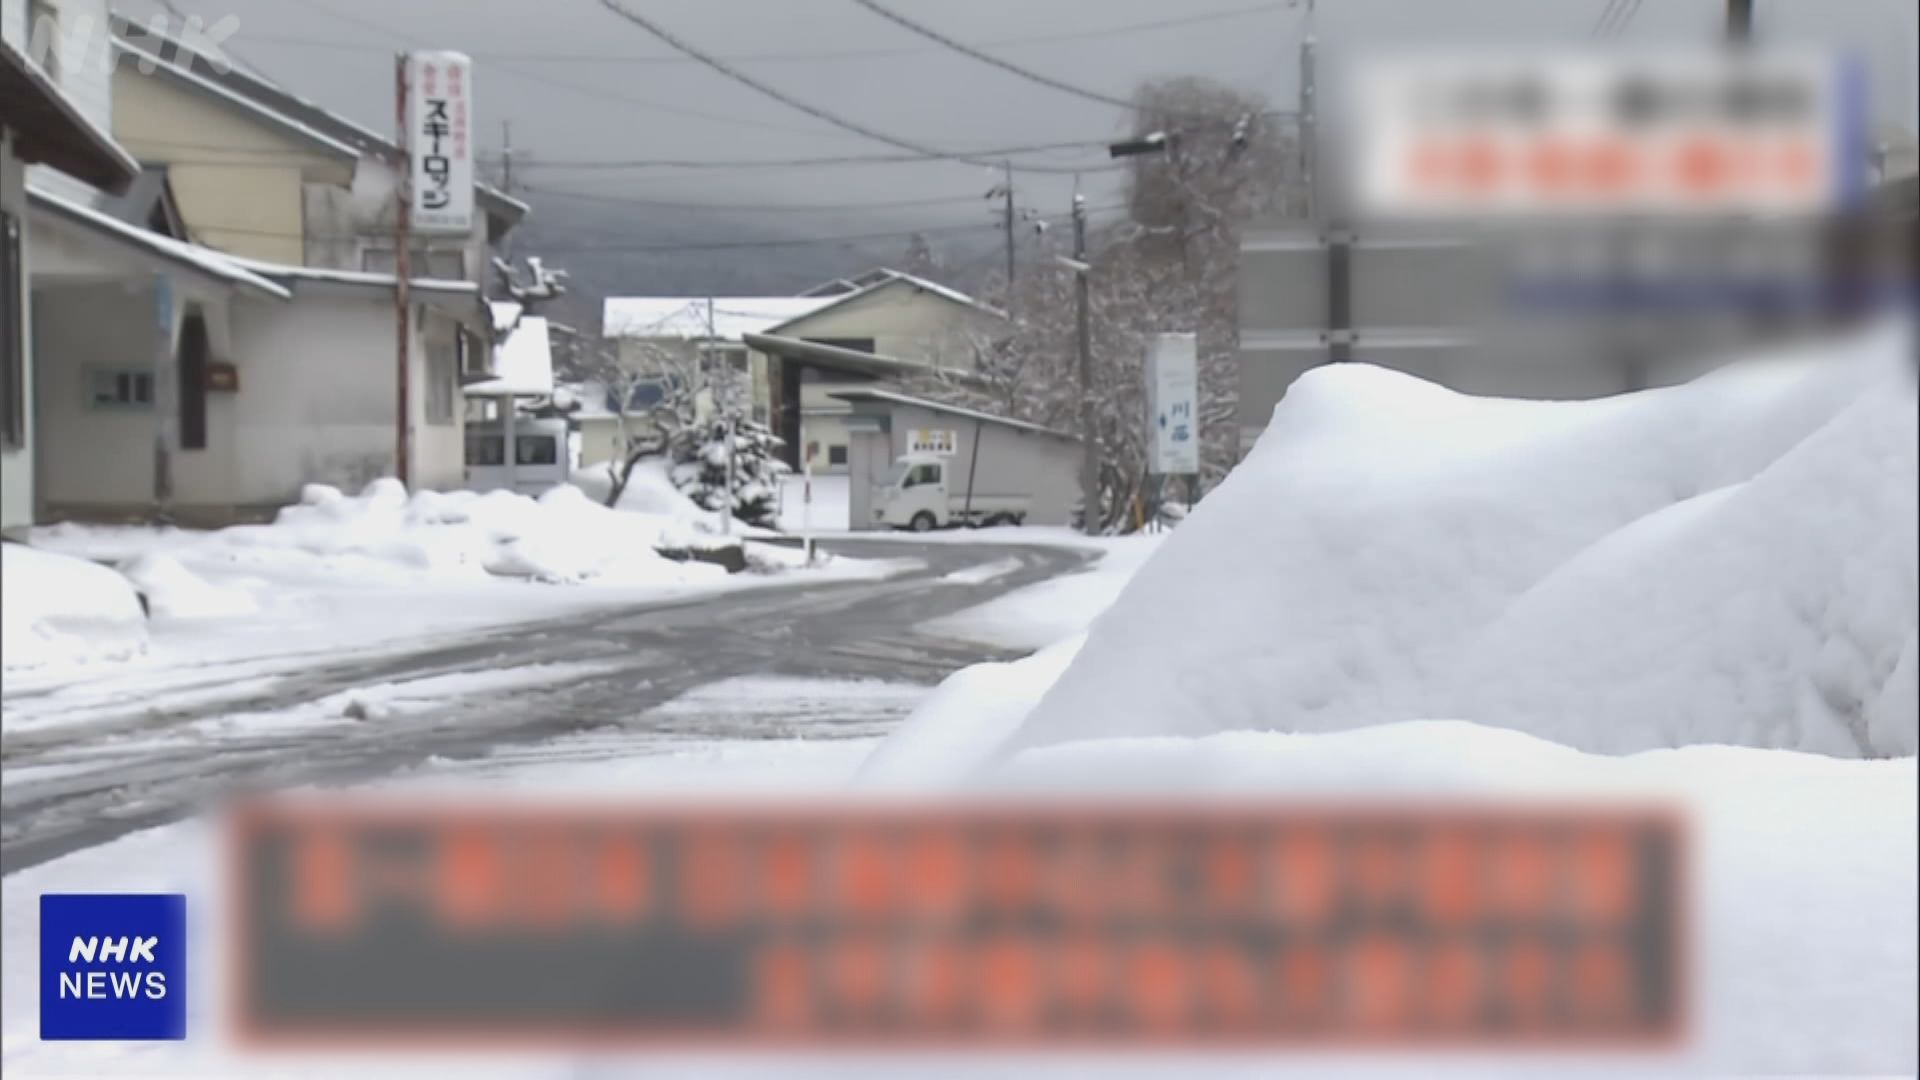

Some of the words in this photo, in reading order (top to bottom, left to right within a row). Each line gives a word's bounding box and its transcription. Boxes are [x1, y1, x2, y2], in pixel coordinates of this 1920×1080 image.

[422, 98, 449, 209] スキーロッジ
